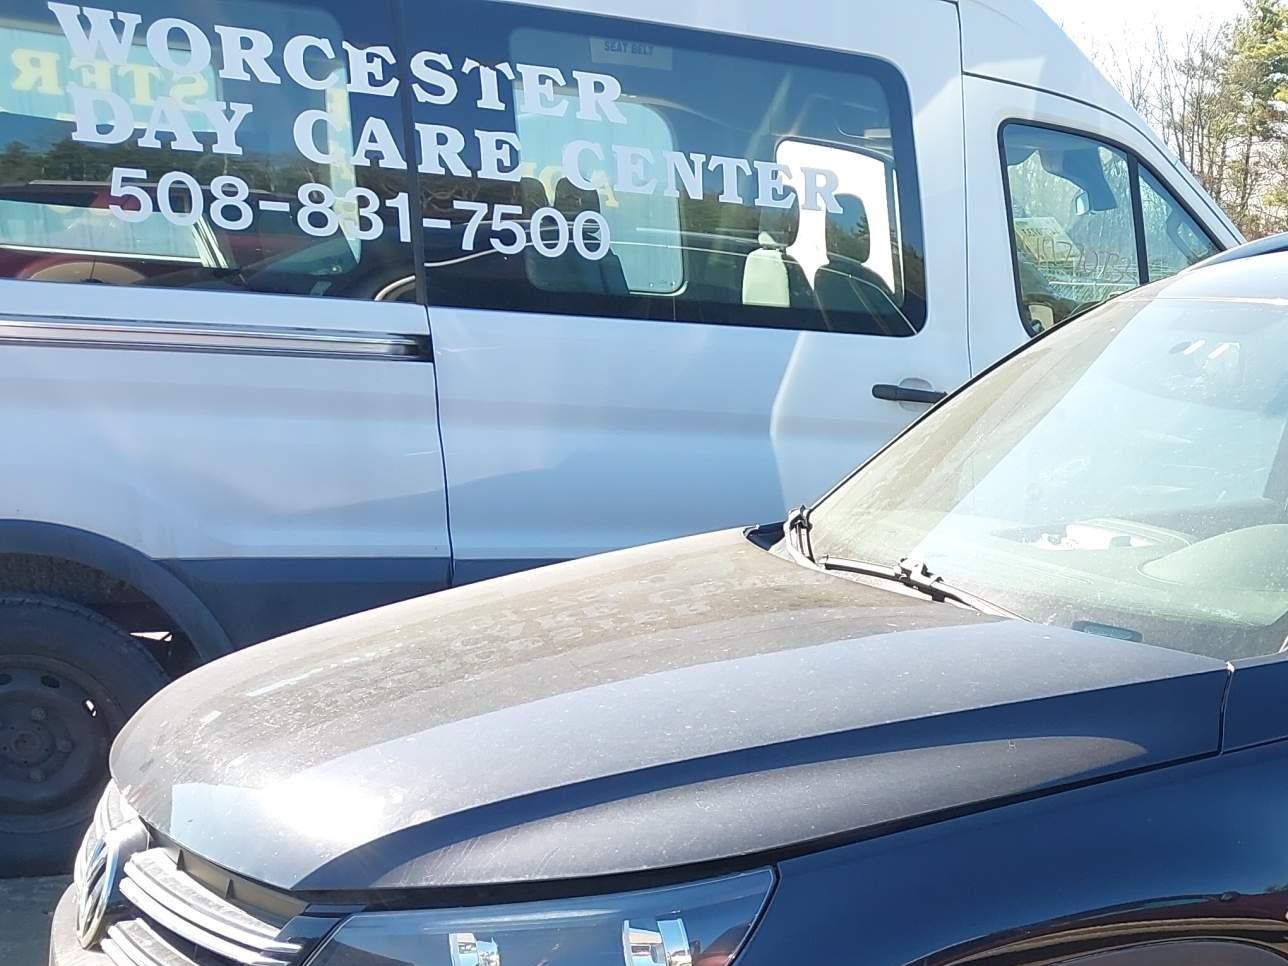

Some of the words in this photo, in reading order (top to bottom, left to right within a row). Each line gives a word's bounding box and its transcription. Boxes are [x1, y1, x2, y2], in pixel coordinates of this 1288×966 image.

[48, 2, 627, 124] WORCESTER
[67, 82, 253, 155] DAY
[293, 109, 522, 182] CARE
[561, 139, 843, 214] CENTER
[108, 167, 610, 260] 508-831-7500
